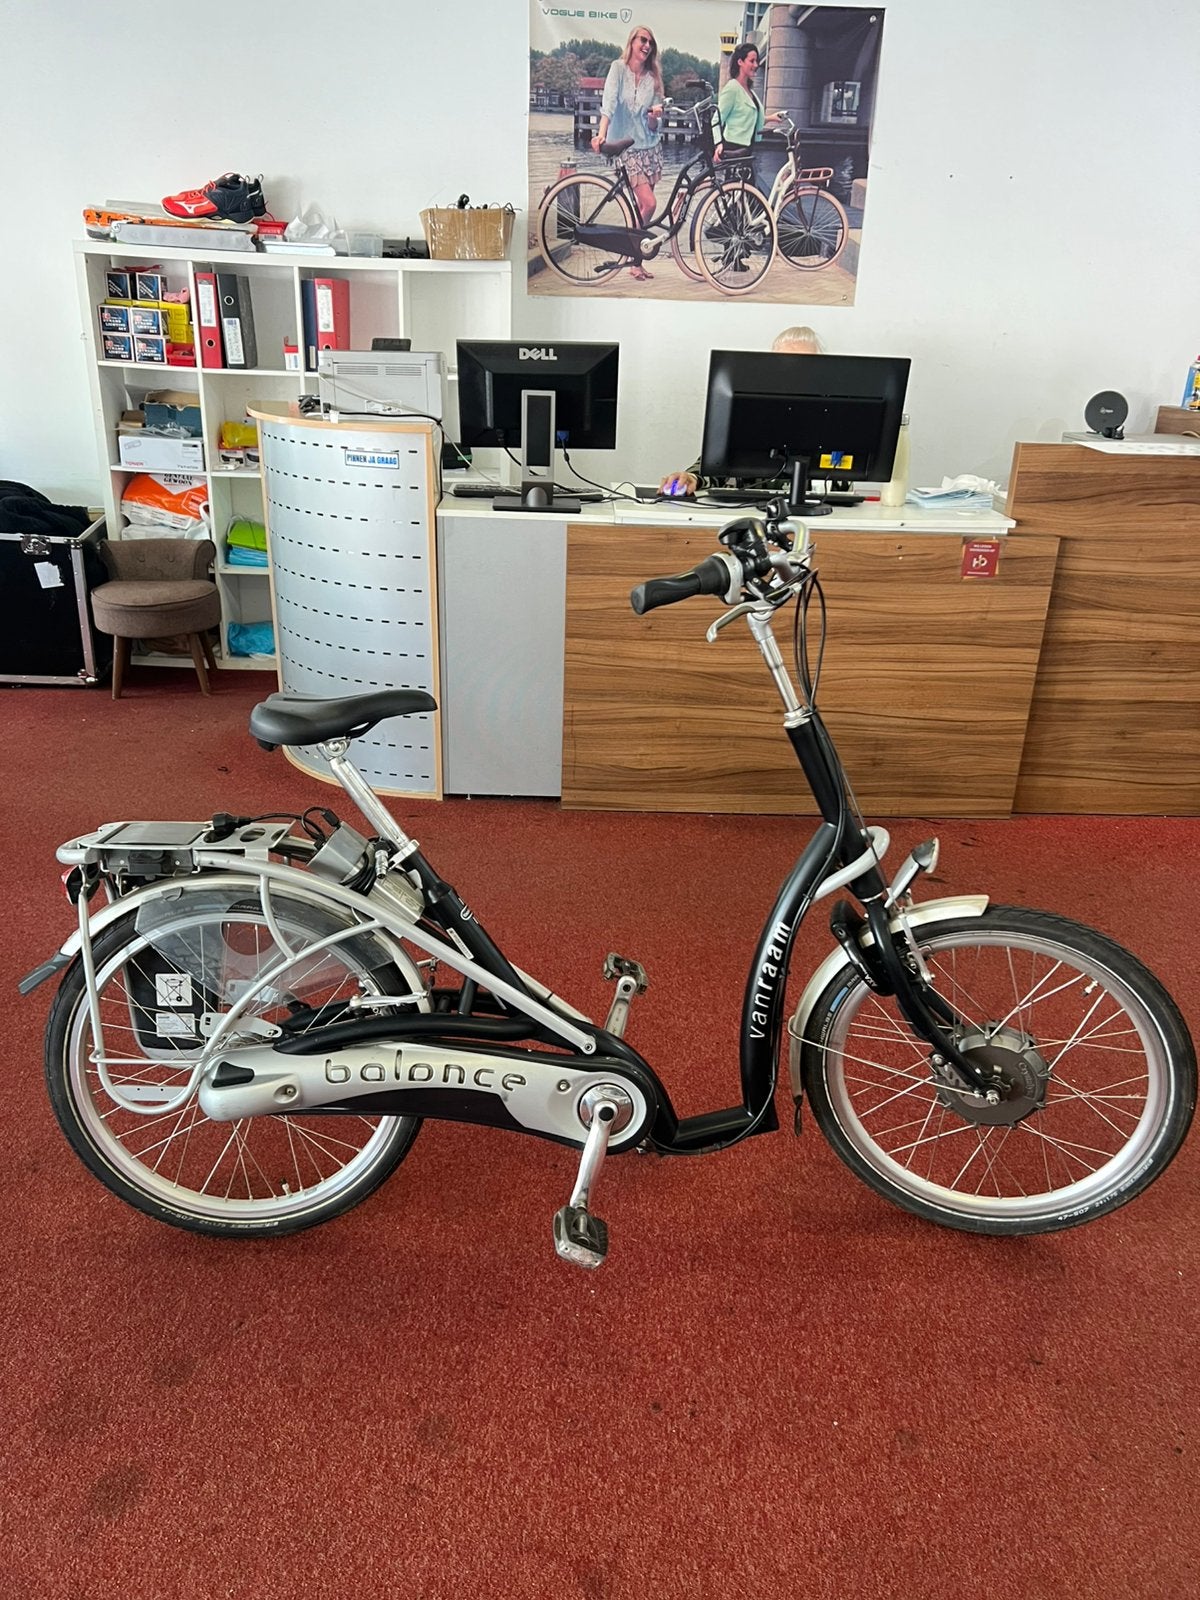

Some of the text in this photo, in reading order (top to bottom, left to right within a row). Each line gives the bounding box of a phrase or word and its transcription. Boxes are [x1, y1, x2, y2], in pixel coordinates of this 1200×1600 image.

[542, 8, 618, 19] VOGUE BIKE
[519, 348, 558, 360] DELL
[368, 455, 376, 464] JA
[325, 1049, 527, 1092] balance
[1057, 1206, 1090, 1221] 47-507
